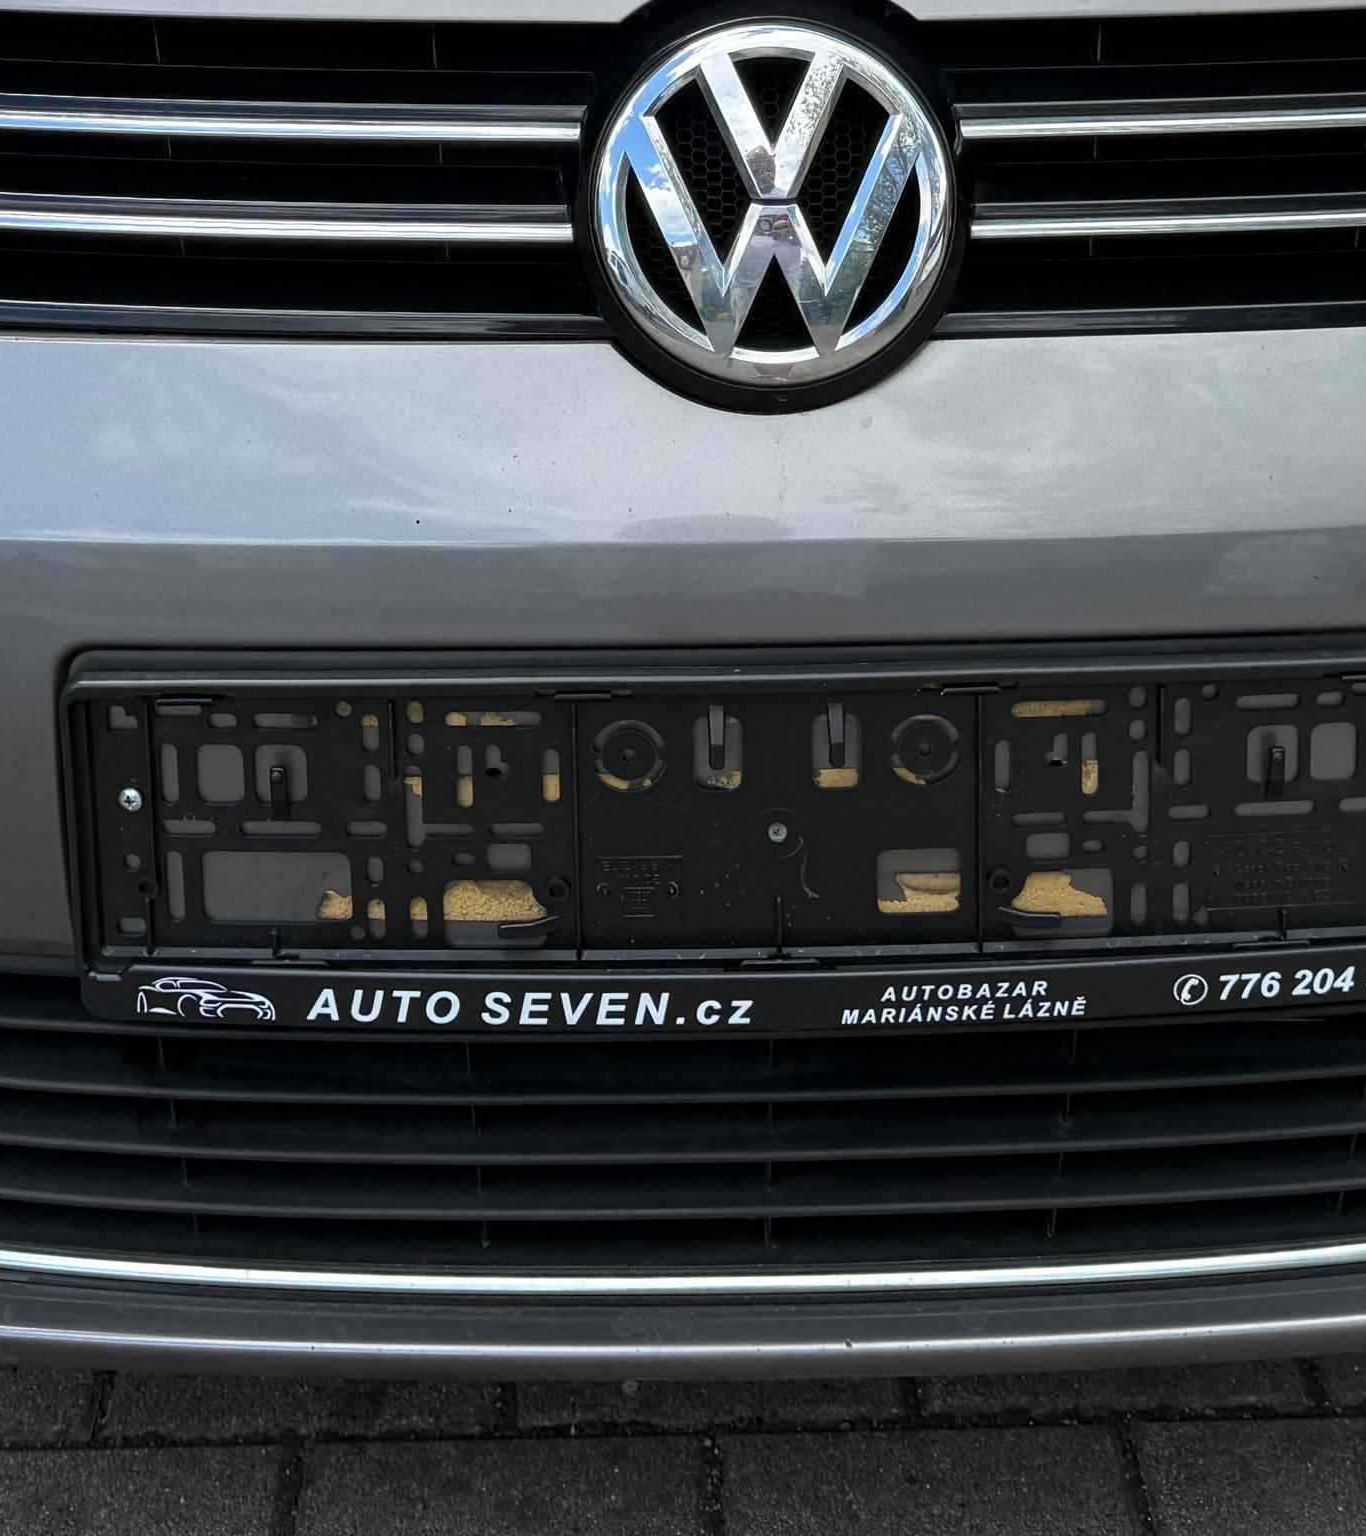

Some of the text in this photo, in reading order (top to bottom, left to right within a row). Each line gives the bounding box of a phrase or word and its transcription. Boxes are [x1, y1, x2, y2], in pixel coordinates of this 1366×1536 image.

[610, 32, 938, 371] VW
[880, 980, 1048, 1002] AUTOBAZAR
[1219, 971, 1282, 1001] 776
[1291, 965, 1355, 996] 204
[306, 988, 754, 1026] AUTO SEVEN.cz
[841, 996, 1087, 1025] MARIÁNSKÉ LÁZNĚ
